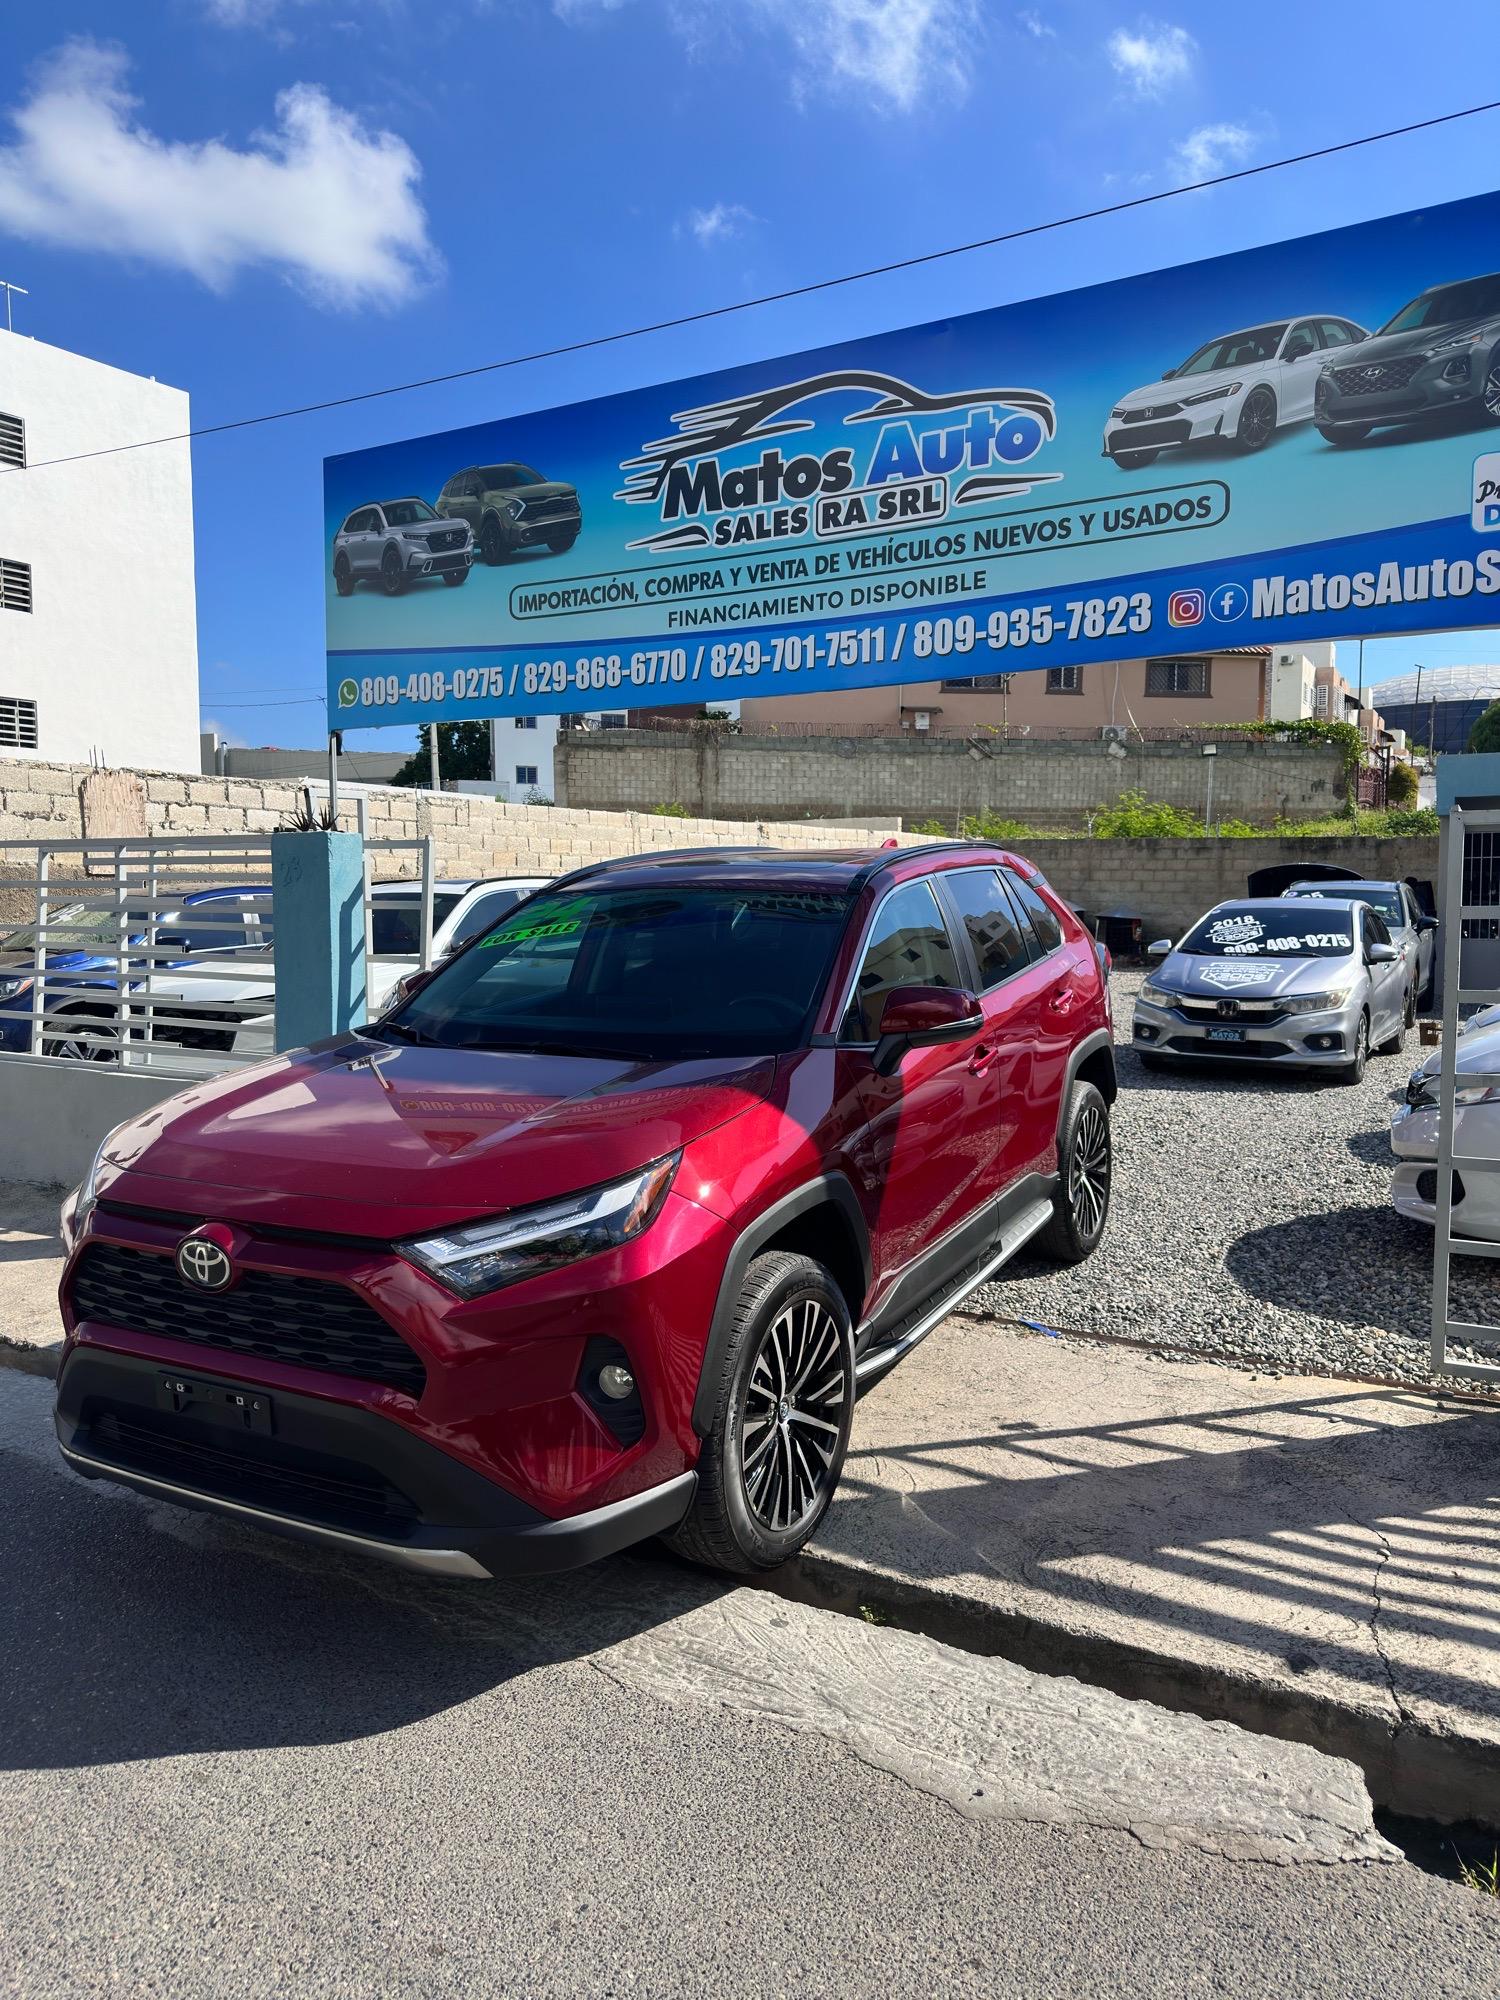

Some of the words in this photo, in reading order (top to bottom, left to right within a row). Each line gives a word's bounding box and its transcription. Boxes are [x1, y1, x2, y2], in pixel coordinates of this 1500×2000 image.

[662, 450, 854, 520] Matos
[865, 410, 1042, 486] Auto
[714, 506, 808, 546] SALES
[822, 498, 868, 530] RA
[878, 484, 941, 520] SRL
[518, 577, 640, 613] IMPORTACIÓN,
[644, 569, 725, 598] COMPRA
[729, 566, 742, 587] Y
[747, 558, 809, 584] VENTA
[814, 552, 841, 576] DE
[846, 533, 967, 571] VEHÍCULOS
[973, 517, 1072, 552] NUEVOS
[1079, 512, 1097, 536] Y
[1103, 495, 1213, 533] USADOS
[1251, 549, 1500, 620] MatosAutoS
[668, 590, 844, 628] FINANCIAMIENTO
[850, 569, 987, 607] DISPONIBLE
[361, 666, 505, 706] 809-408-0275
[508, 663, 520, 696] /
[523, 647, 687, 694] 829-868-6770
[692, 645, 705, 680] /
[710, 626, 886, 678] 829-701-7511
[891, 622, 907, 661] /
[913, 592, 1153, 658] 809-935-7823
[481, 931, 519, 947] FOR
[525, 921, 578, 938] SALE
[1212, 915, 1256, 929] 2018
